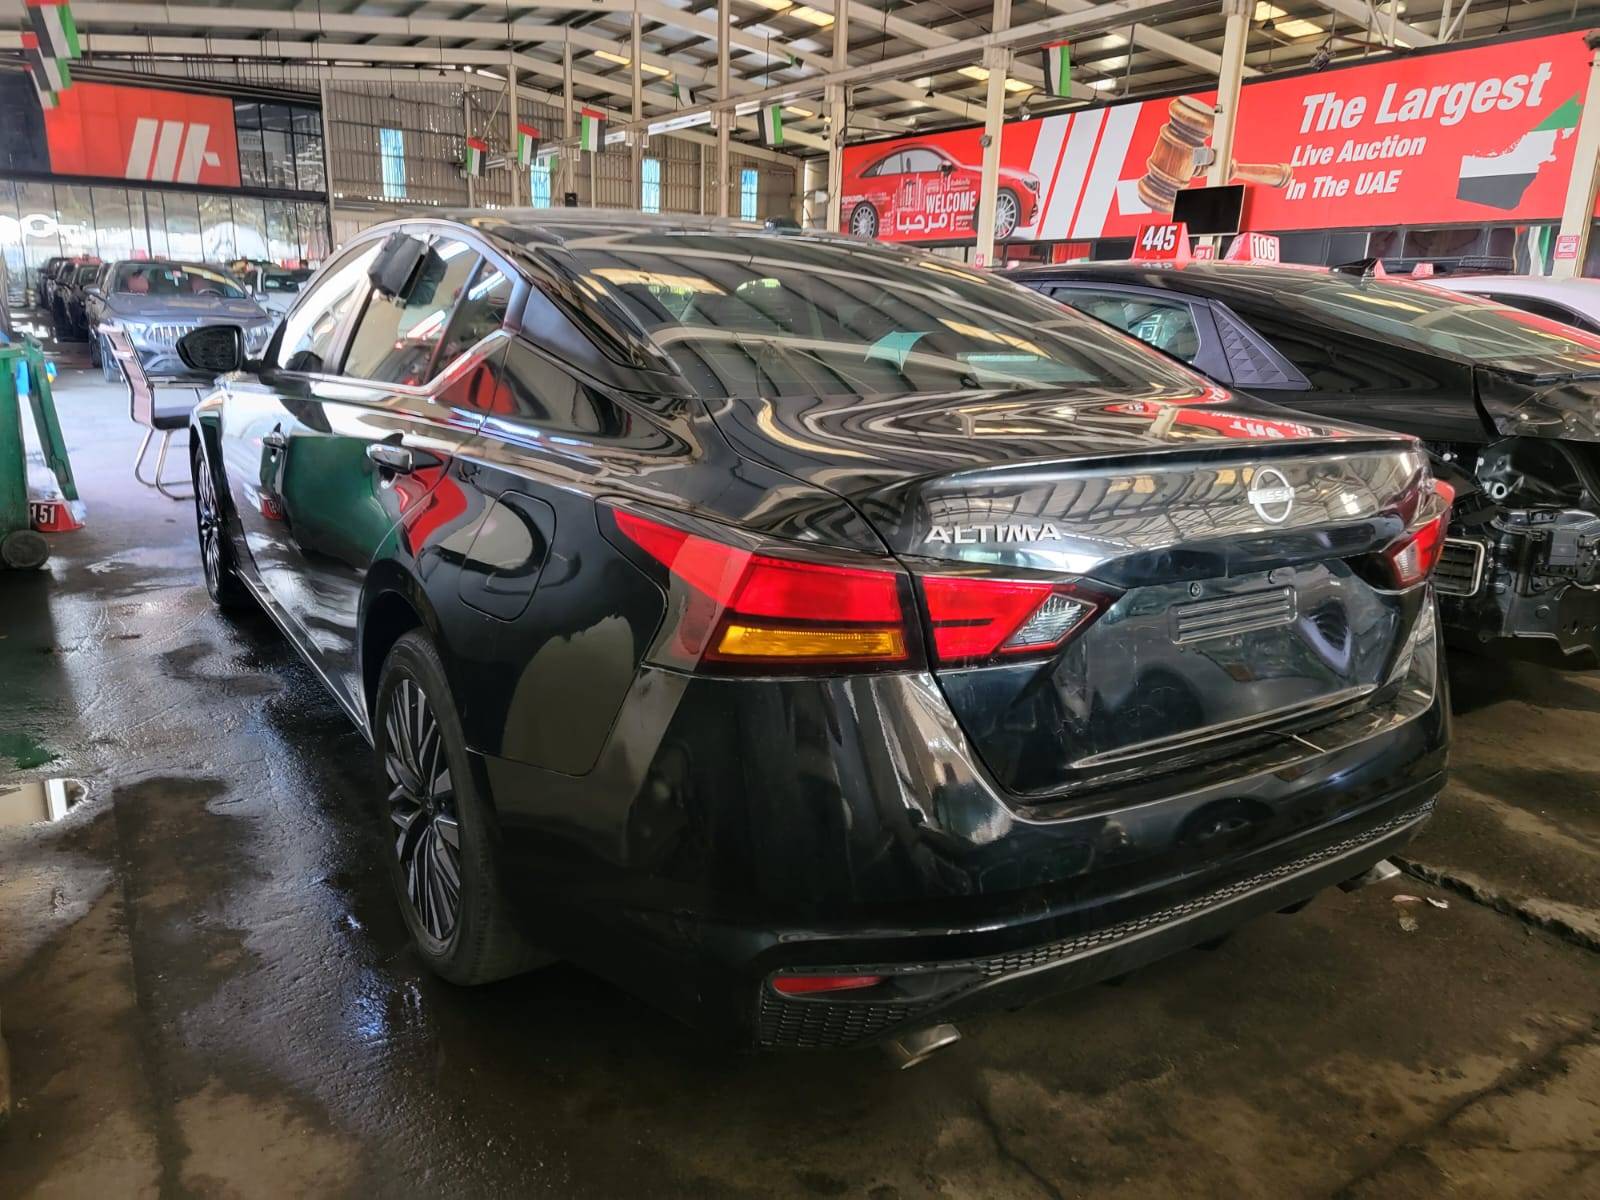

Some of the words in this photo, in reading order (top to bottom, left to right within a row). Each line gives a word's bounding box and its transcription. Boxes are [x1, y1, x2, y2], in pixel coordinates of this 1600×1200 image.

[1300, 92, 1367, 134] The
[1375, 62, 1552, 126] Largest
[1291, 145, 1334, 168] Live
[1337, 135, 1427, 164] Auction
[1285, 179, 1306, 200] In
[1313, 174, 1351, 197] The
[1355, 169, 1403, 195] UAE
[926, 191, 976, 214] WELCOME
[897, 212, 949, 233] مرحبا
[1142, 225, 1178, 251] 445
[1253, 236, 1275, 261] 106
[31, 504, 55, 524] 151
[924, 522, 1062, 544] ALTIMA
